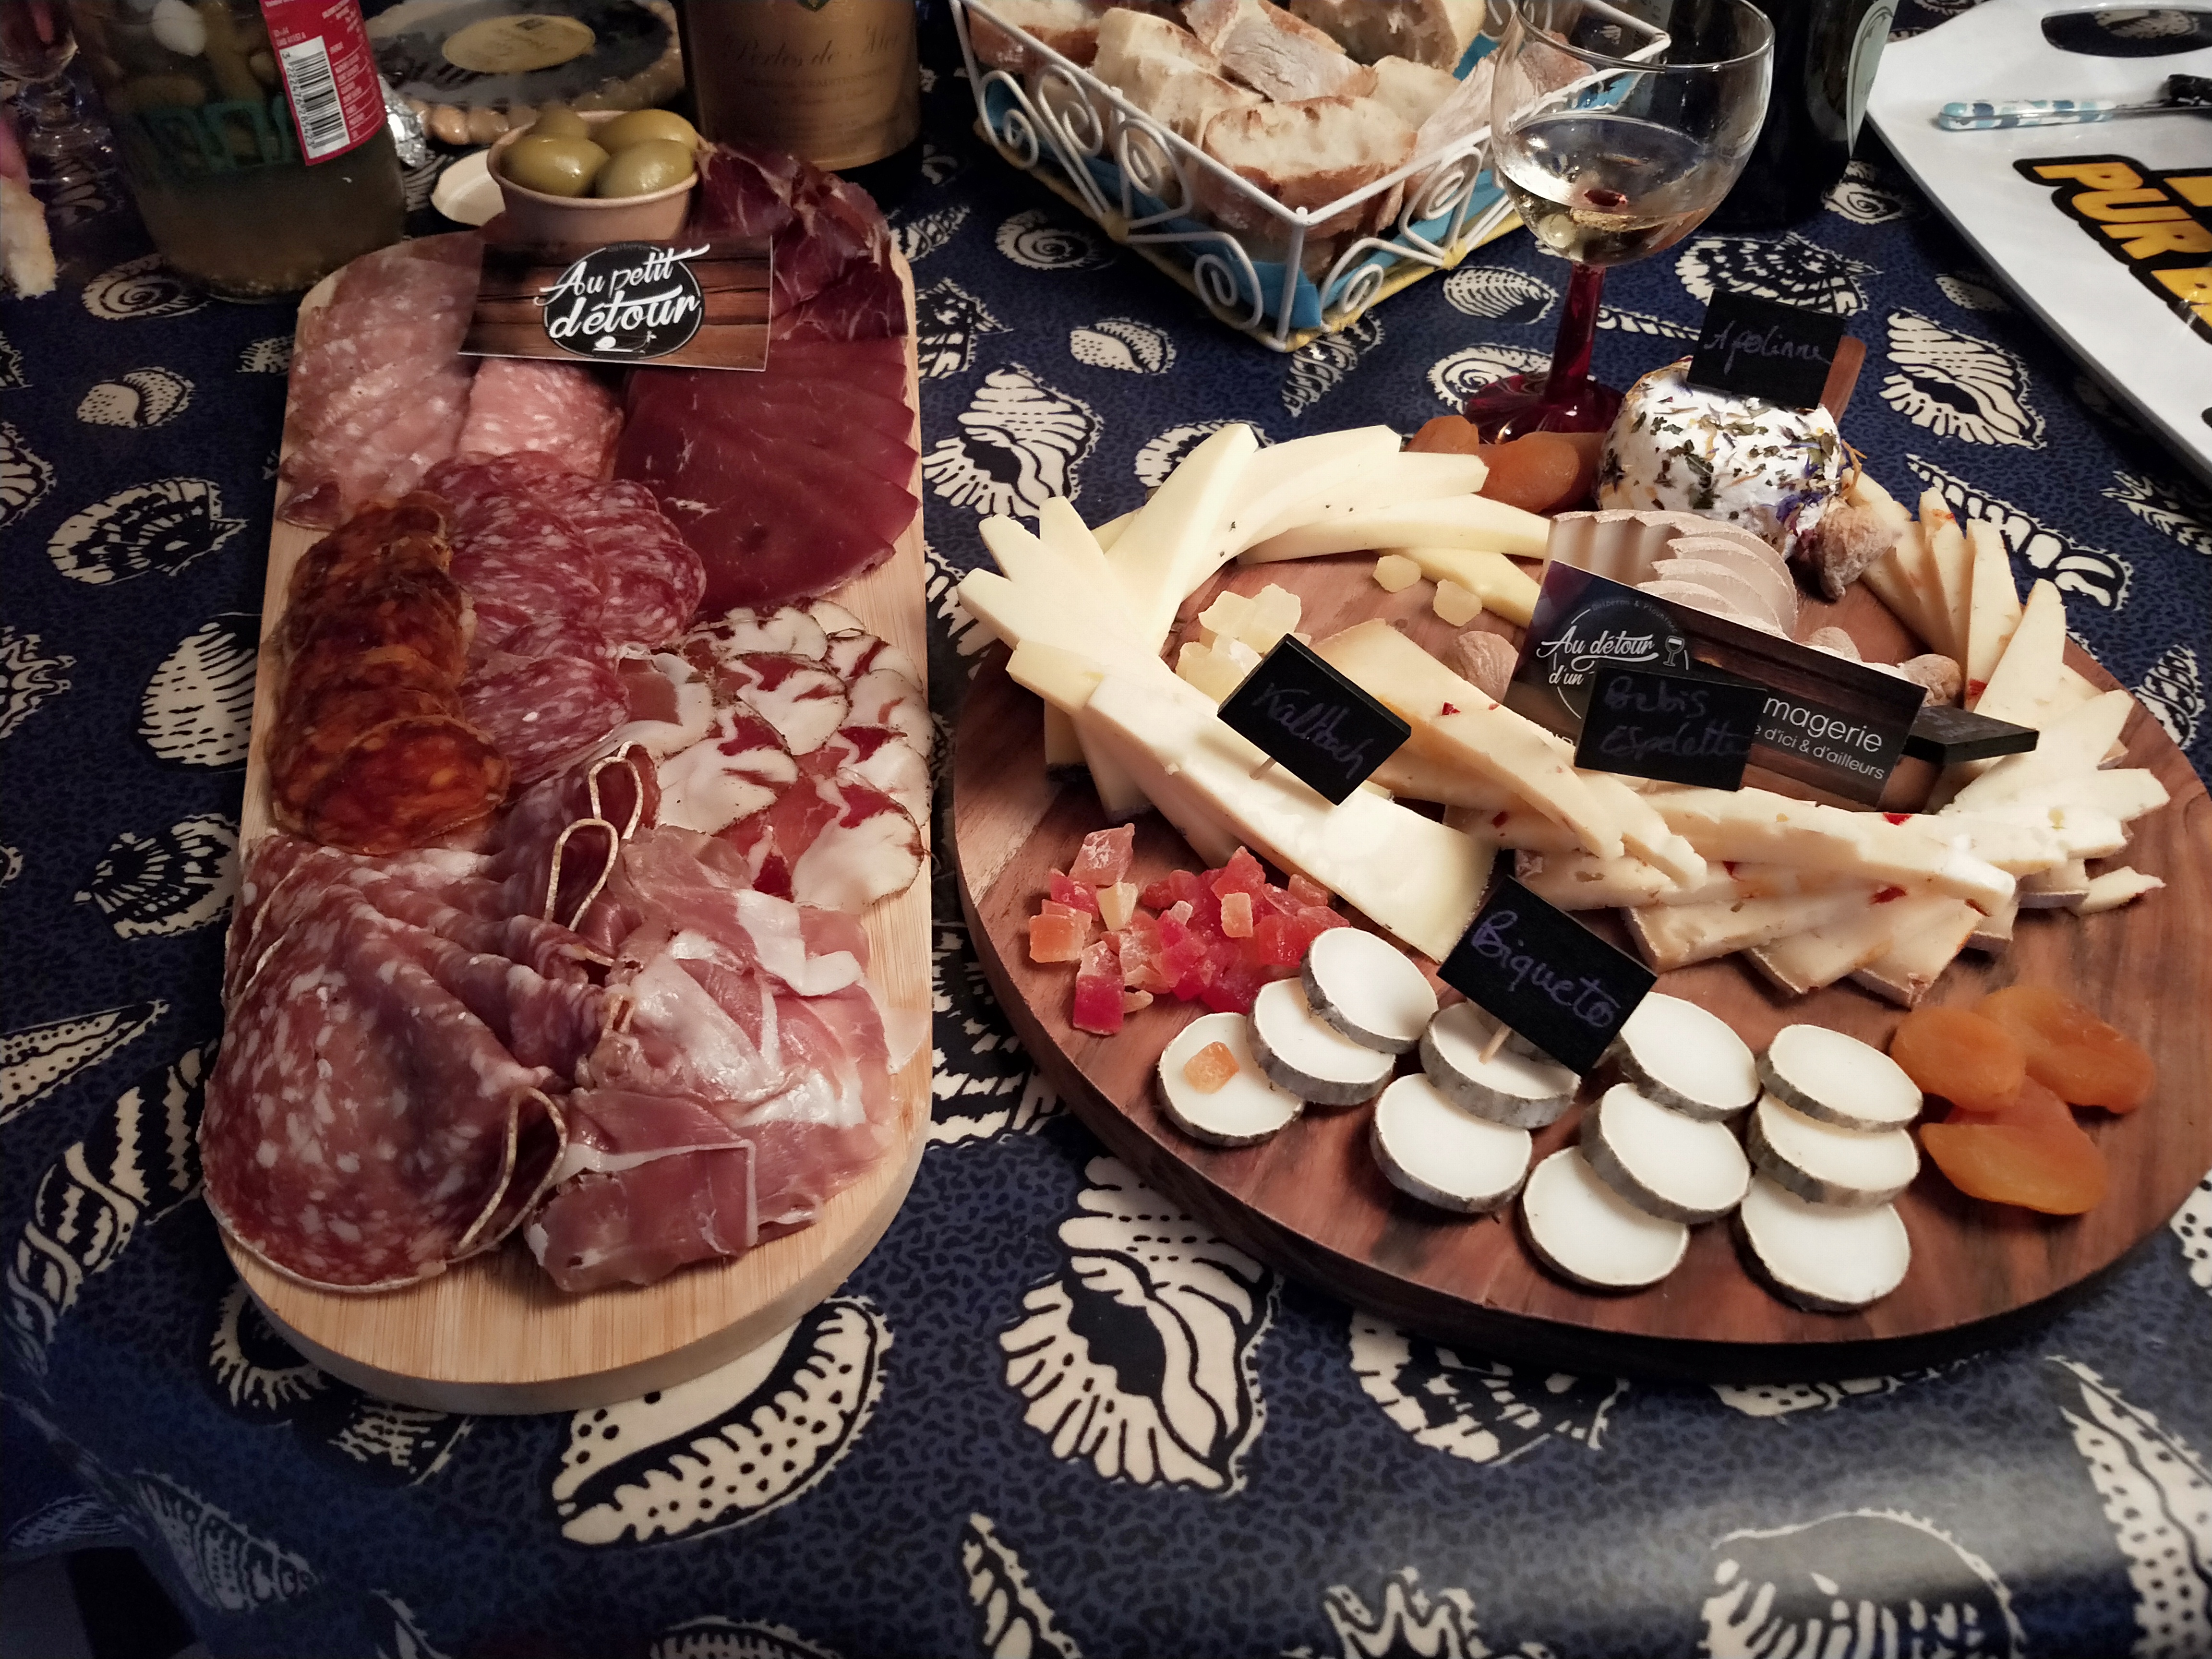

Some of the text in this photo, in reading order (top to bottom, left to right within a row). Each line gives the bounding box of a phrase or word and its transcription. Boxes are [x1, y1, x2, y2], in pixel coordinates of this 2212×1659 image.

[2032, 161, 2212, 260] PUR
[533, 243, 710, 306] Au petit
[549, 285, 701, 339] détour
[1536, 625, 1659, 662] Au détour
[1548, 664, 1585, 685] d'un
[1764, 727, 1799, 748] d'ici
[1798, 739, 1810, 753] &
[1813, 745, 1886, 780] d'ailleurs
